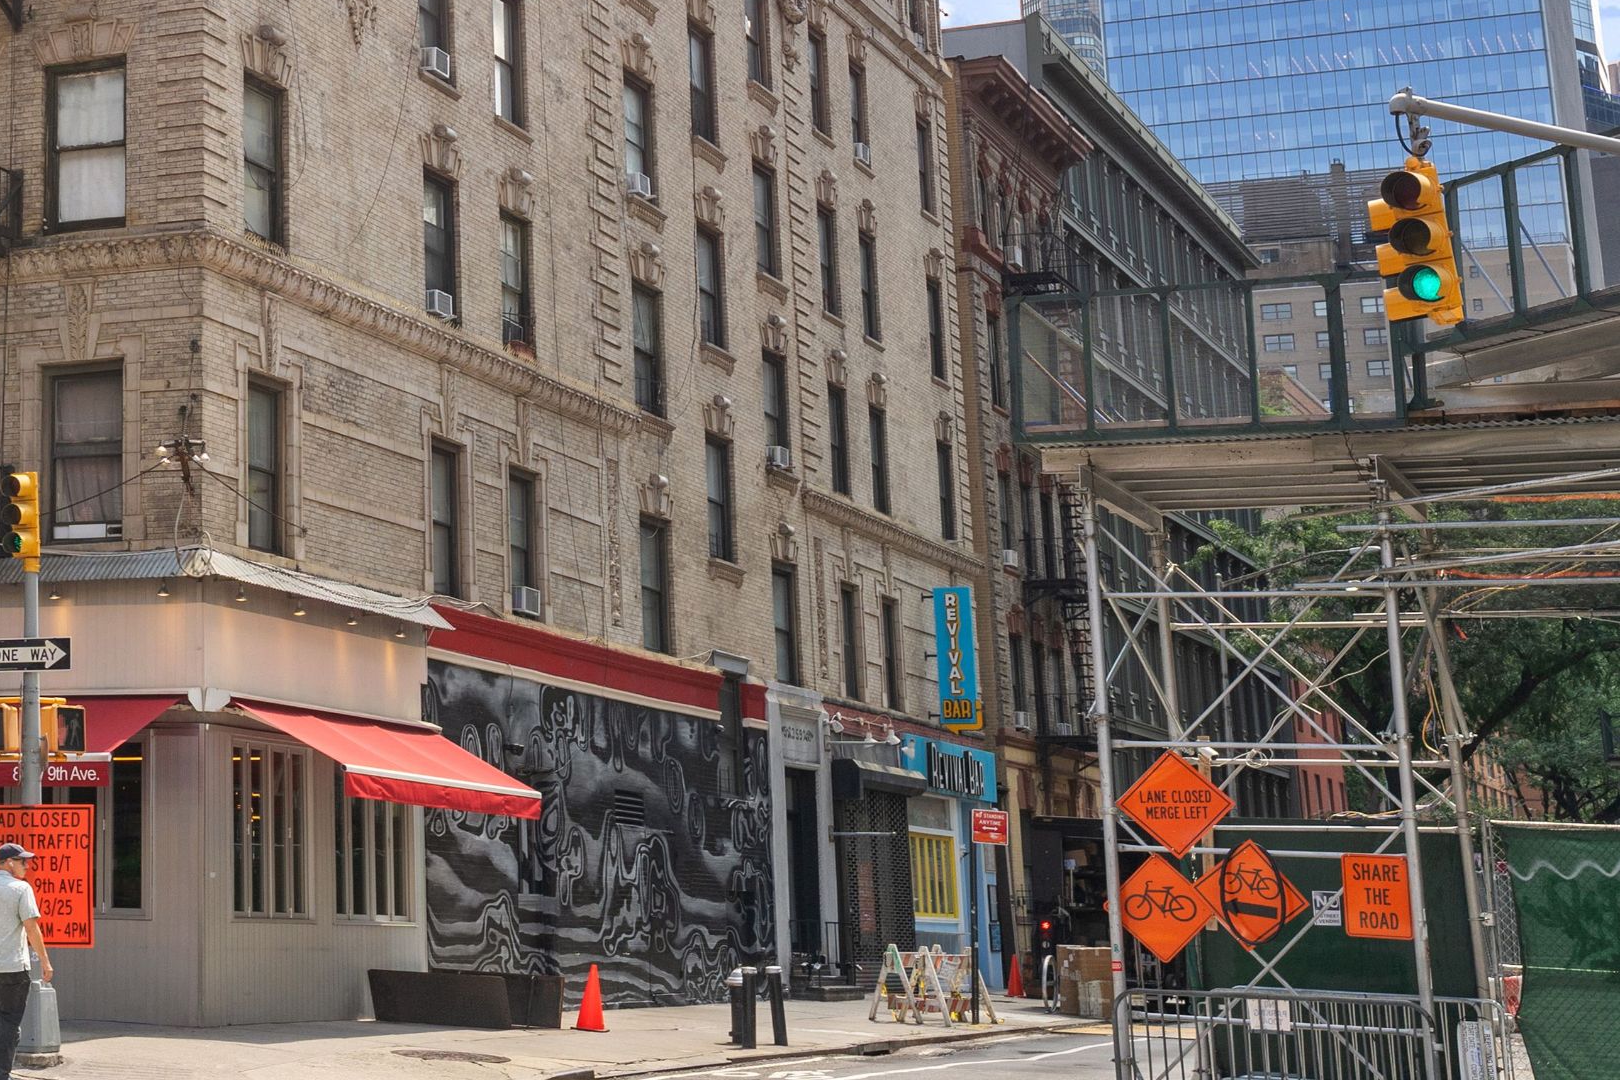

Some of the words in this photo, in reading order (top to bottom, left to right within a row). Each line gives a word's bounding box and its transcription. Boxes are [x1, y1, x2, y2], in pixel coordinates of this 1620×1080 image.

[945, 593, 963, 695] REVIVAL
[30, 647, 58, 661] WAY
[943, 699, 972, 719] BAR
[47, 766, 68, 781] 9th
[70, 766, 100, 781] Ave.
[929, 742, 968, 793] REVIVAL
[967, 751, 984, 796] BAR
[1140, 790, 1168, 803] LANE
[1171, 790, 1211, 803] CLOSED
[21, 812, 80, 828] CLOSED
[1146, 807, 1180, 819] MERGE
[1184, 807, 1208, 819] LEFT
[28, 833, 90, 850] TRAFFIC
[31, 856, 46, 872] ST
[50, 855, 72, 873] B/T
[1352, 863, 1401, 882] SHARE
[35, 878, 55, 894] 9th
[59, 879, 84, 894] AVE
[1365, 887, 1392, 906] THE
[39, 897, 73, 917] /3/25
[1359, 911, 1399, 930] ROAD
[64, 922, 87, 938] 4PM
